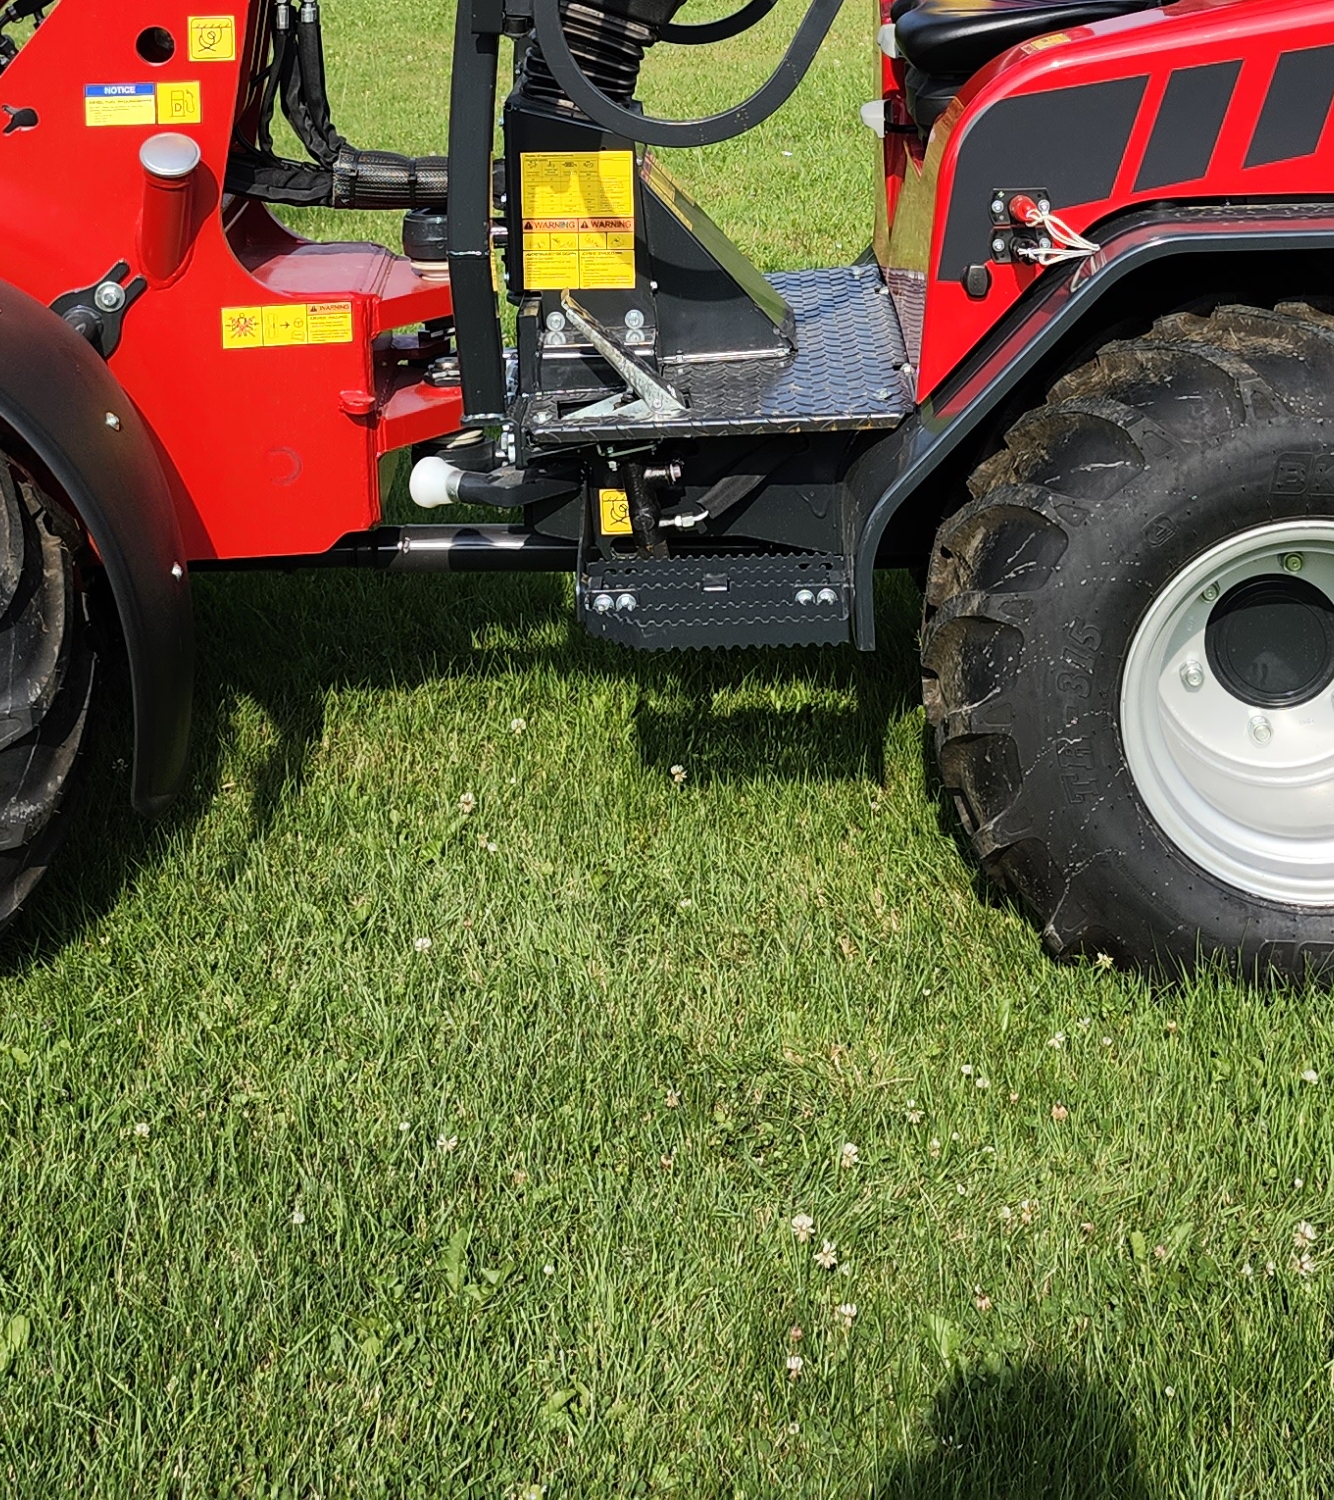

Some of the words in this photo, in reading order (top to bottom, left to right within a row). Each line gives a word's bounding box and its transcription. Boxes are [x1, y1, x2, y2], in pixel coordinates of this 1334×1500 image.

[104, 86, 137, 95] NOTICE
[534, 221, 576, 229] WARNING
[590, 220, 632, 229] WARNING
